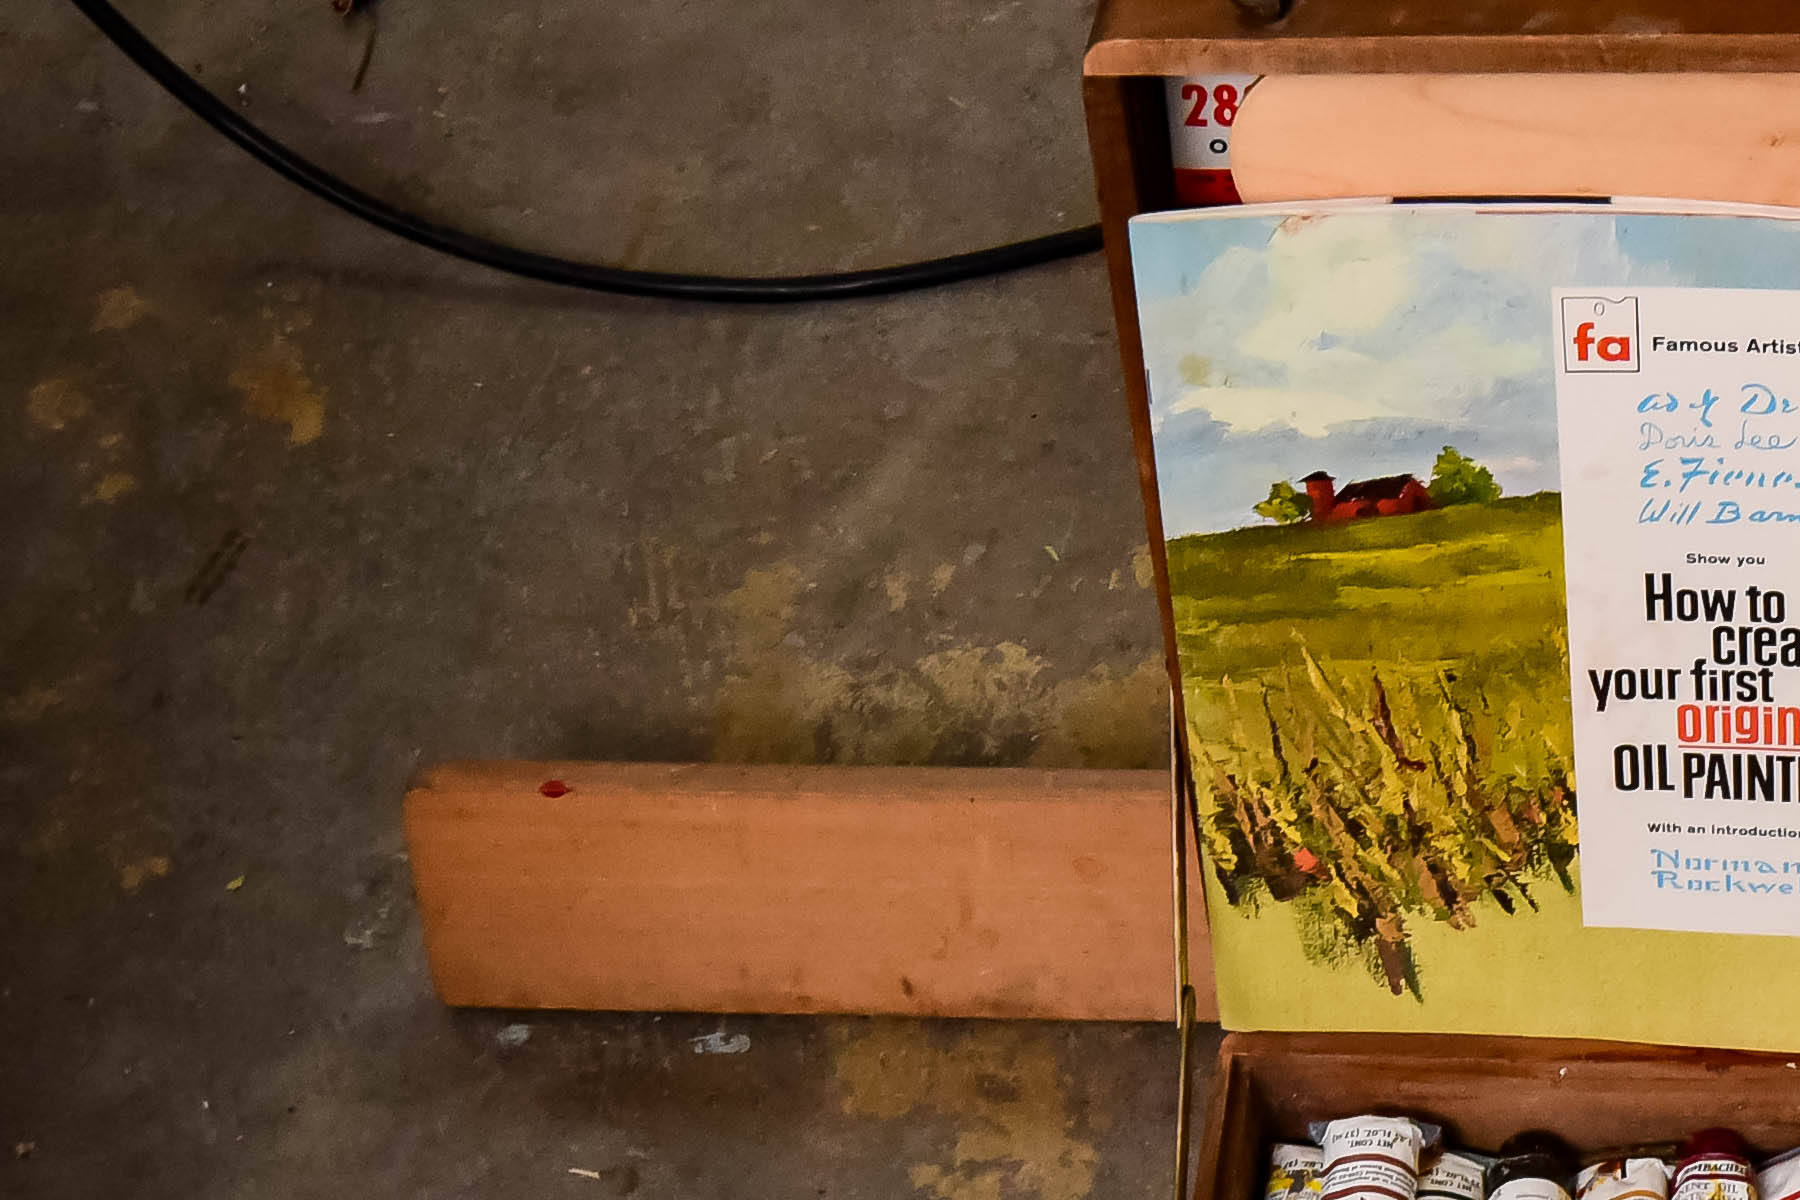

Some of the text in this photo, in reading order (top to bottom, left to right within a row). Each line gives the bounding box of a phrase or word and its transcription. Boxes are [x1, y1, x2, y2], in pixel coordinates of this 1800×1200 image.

[1573, 322, 1631, 361] fa
[1652, 336, 1739, 353] Famous
[1639, 419, 1798, 450] Doris Lee
[1640, 458, 1672, 489] E.
[1637, 498, 1703, 526] Will
[1685, 552, 1766, 568] Show you
[1644, 572, 1786, 624] How to
[1588, 658, 1775, 712] your first
[1612, 743, 1675, 793] OIL
[1647, 821, 1682, 835] With
[1686, 825, 1706, 835] an
